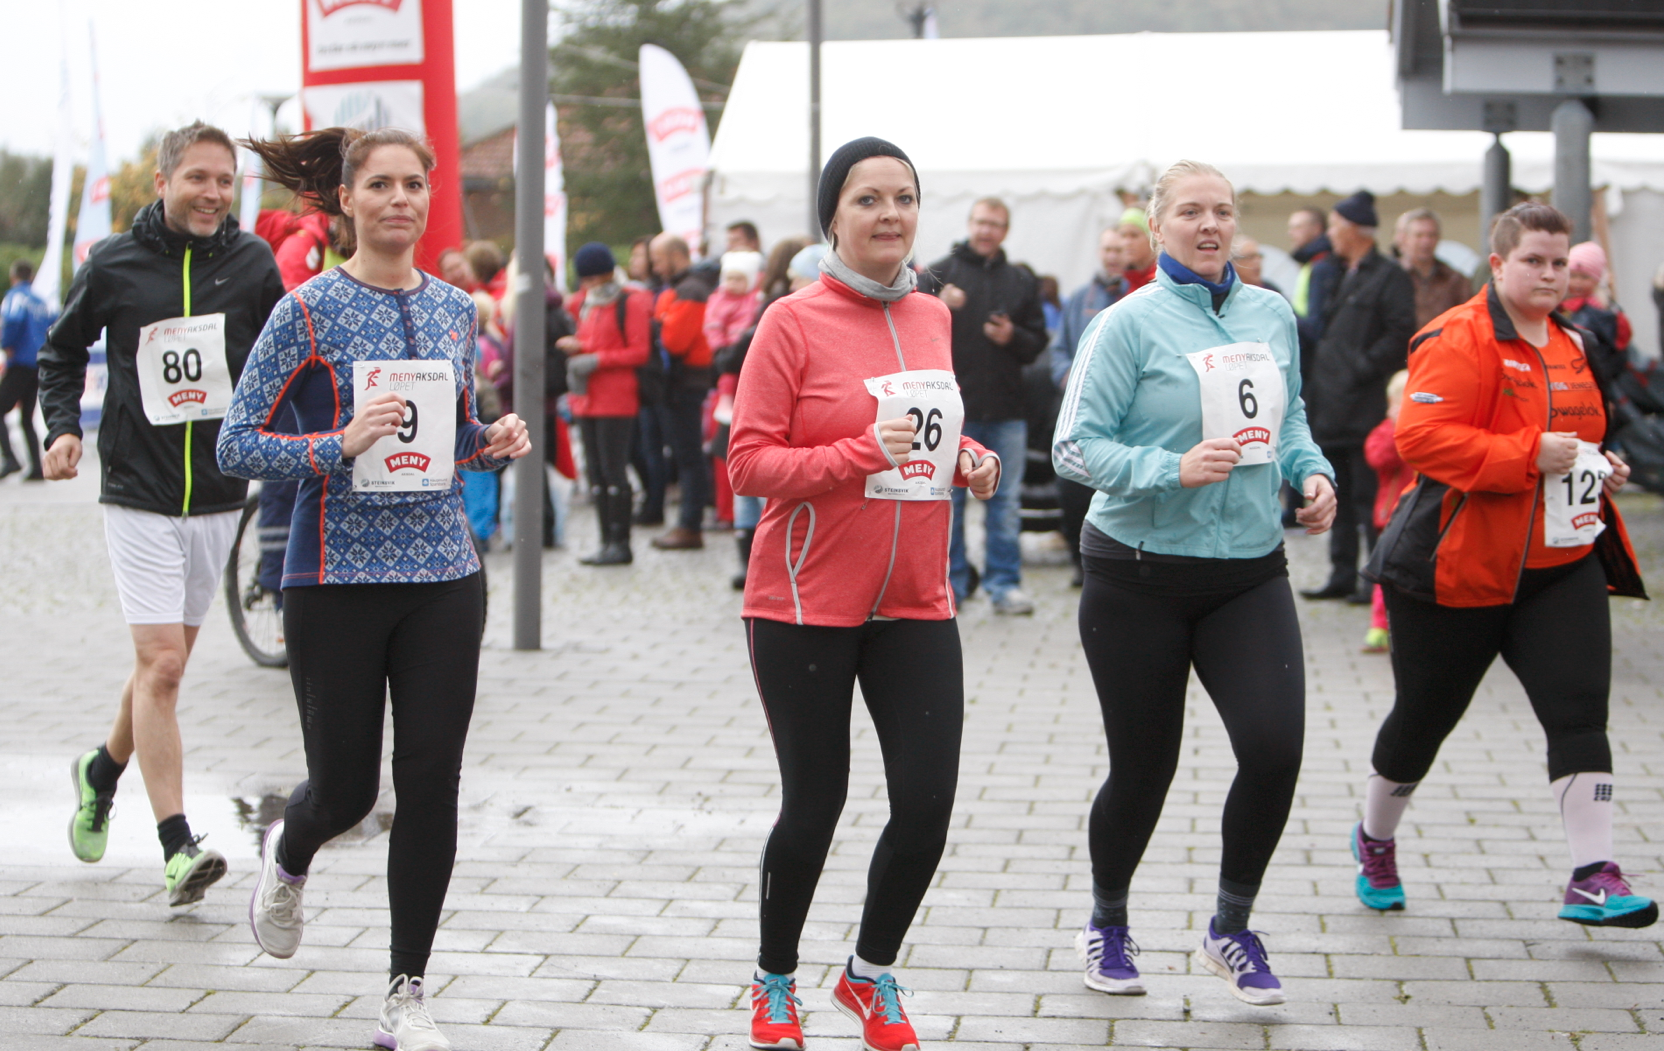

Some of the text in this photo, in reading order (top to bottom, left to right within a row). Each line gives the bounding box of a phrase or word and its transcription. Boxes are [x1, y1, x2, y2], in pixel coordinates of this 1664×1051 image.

[162, 348, 202, 384] 80
[389, 372, 449, 382] MENYAKSDAL
[389, 381, 415, 391] LØPET
[172, 391, 204, 405] MENY
[1238, 378, 1258, 419] 6
[397, 400, 418, 443] 9
[906, 407, 943, 452] 26
[1238, 429, 1269, 443] MENY
[389, 455, 427, 468] MENY
[1575, 514, 1598, 527] MEN
